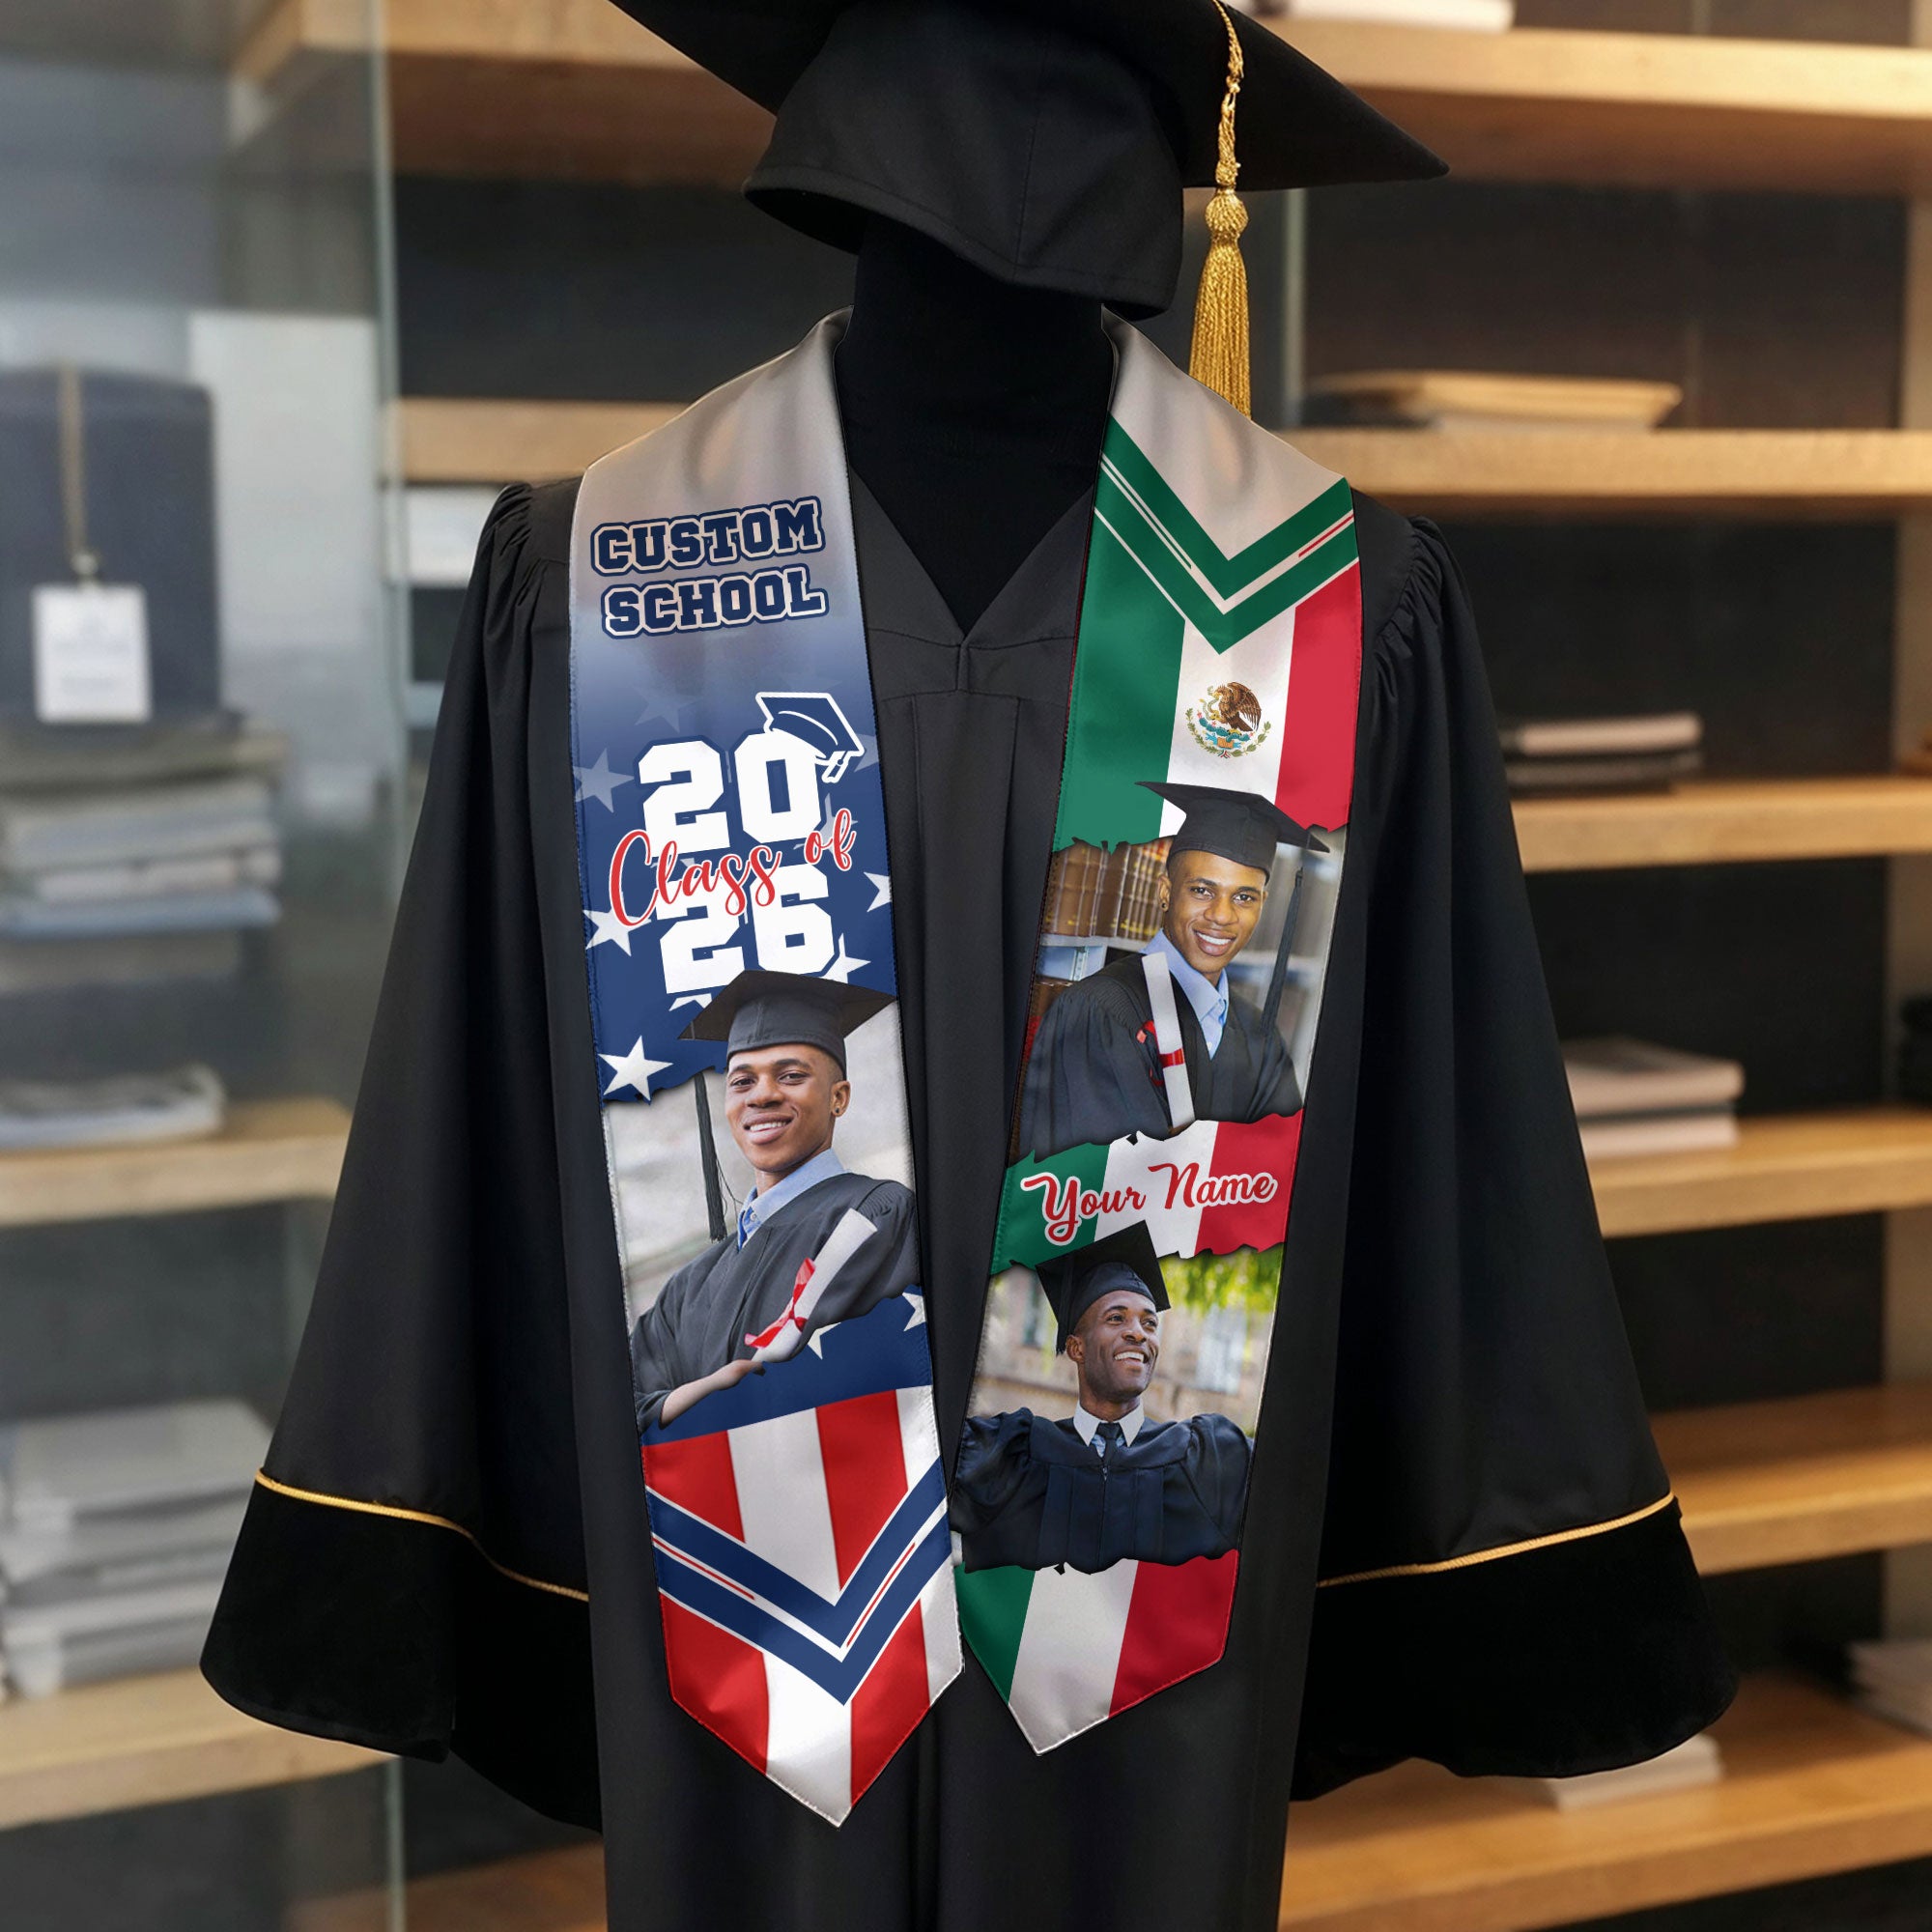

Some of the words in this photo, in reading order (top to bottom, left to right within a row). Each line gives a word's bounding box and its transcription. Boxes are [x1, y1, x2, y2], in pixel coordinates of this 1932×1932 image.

[591, 496, 825, 576] CUSTOM
[601, 563, 829, 639] SCHOOL
[639, 729, 821, 857] 20
[609, 829, 782, 926] Class
[804, 808, 857, 871] of
[656, 863, 835, 993] 26
[1021, 1172, 1147, 1246] Your
[1148, 1162, 1278, 1209] Name
